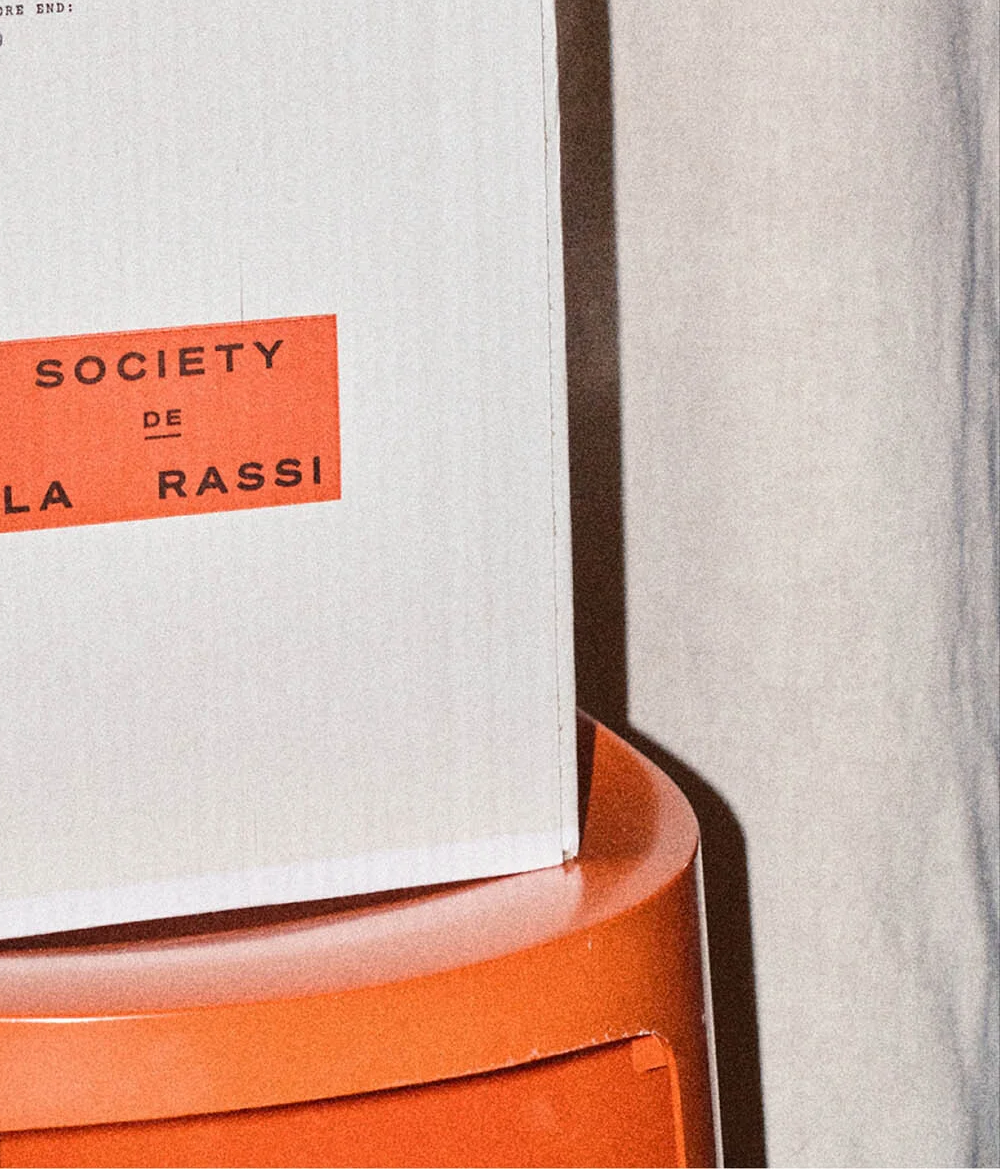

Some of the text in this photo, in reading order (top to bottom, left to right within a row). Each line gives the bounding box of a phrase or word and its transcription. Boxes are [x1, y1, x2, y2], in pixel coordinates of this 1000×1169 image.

[36, 2, 73, 15] END:
[35, 339, 284, 389] SOCIETY
[143, 408, 182, 429] DE
[3, 455, 321, 515] LA RASSI
